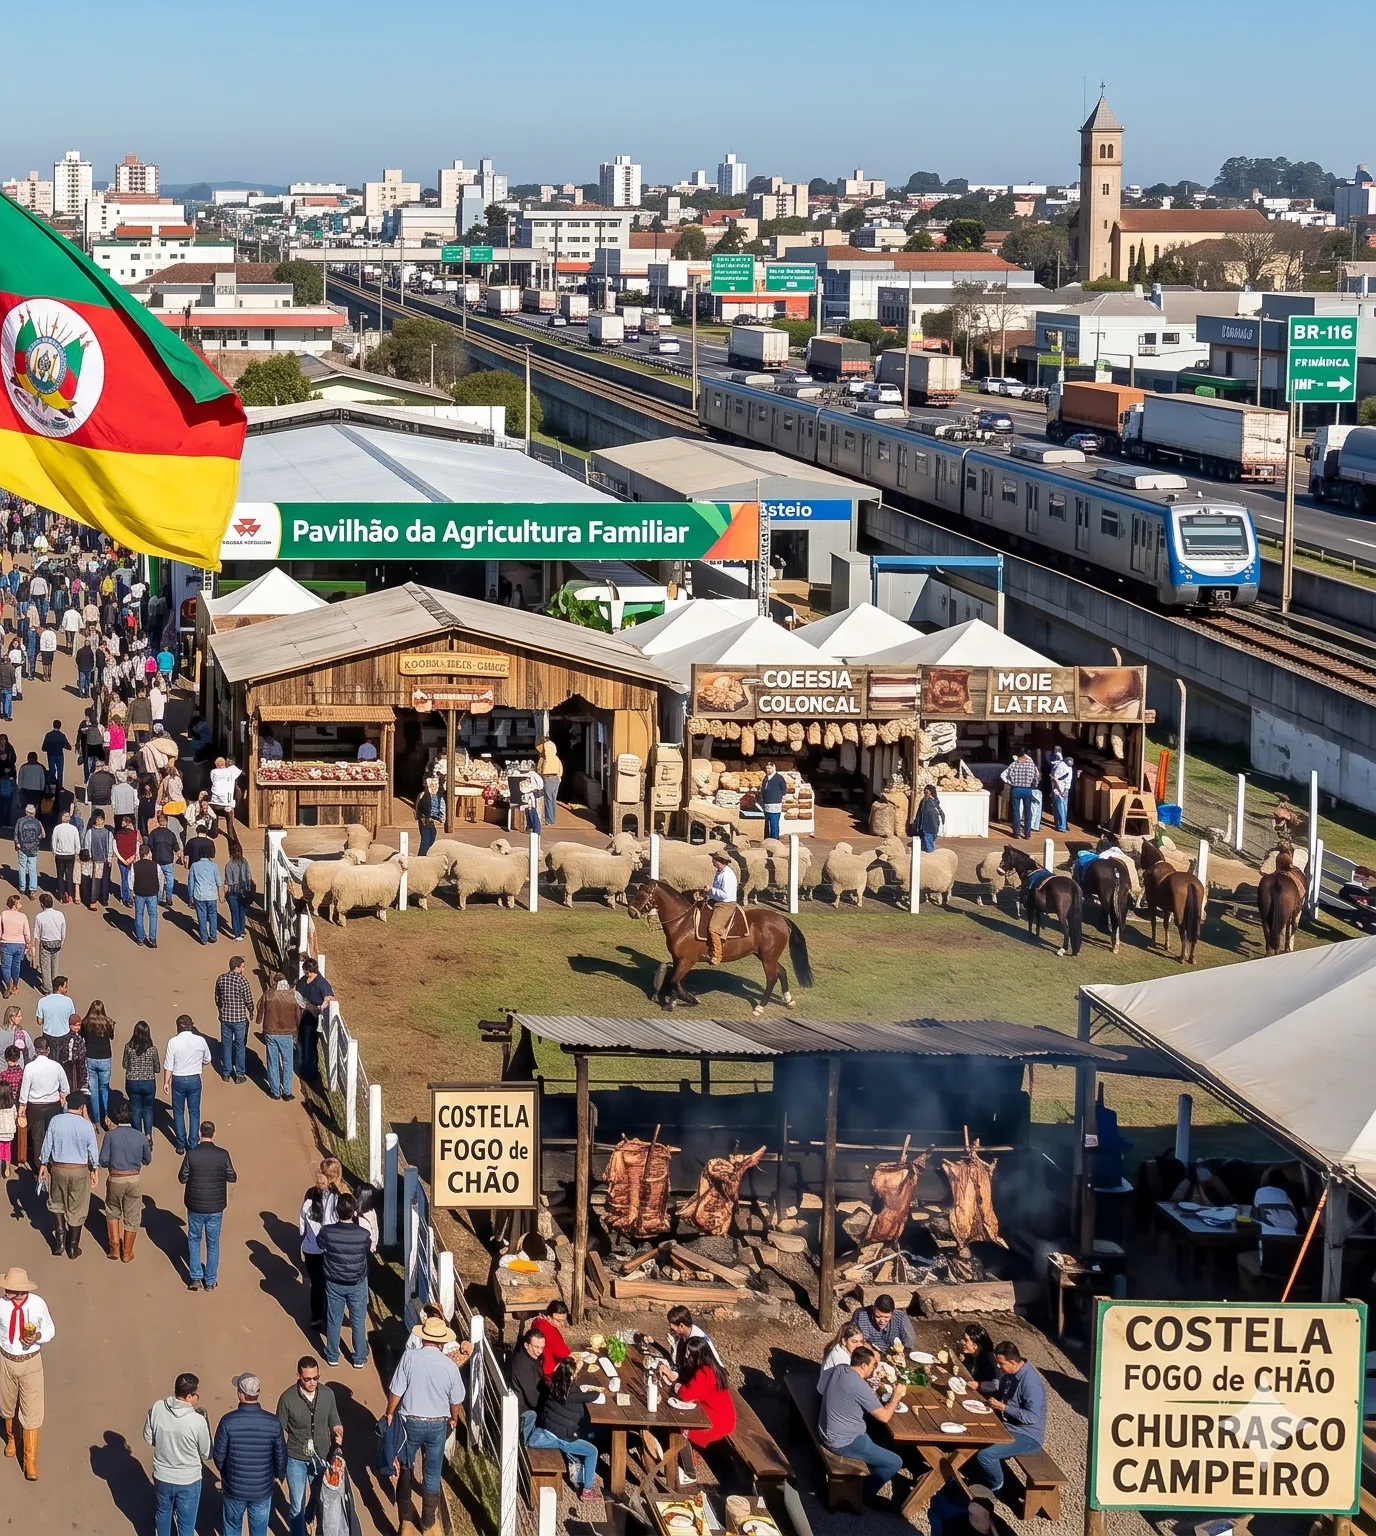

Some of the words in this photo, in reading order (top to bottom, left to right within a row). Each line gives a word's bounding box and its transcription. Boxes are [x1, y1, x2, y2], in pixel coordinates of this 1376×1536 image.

[1294, 324, 1352, 340] BR-116
[293, 518, 399, 543] Pavilhão
[405, 518, 436, 543] da
[442, 520, 582, 549] Agricultura
[588, 520, 690, 543] Familiar
[764, 670, 852, 688] COEESIA
[998, 672, 1052, 690] MOIE
[758, 696, 860, 713] COLONCAL
[994, 696, 1068, 714] LATRA
[438, 1104, 530, 1129] COSTELA
[440, 1139, 504, 1161] FOGO
[509, 1140, 528, 1160] de
[447, 1166, 520, 1194] CHÃO
[1125, 1315, 1333, 1354] COSTELA
[1124, 1364, 1202, 1391] FOGO
[1212, 1366, 1244, 1392] de
[1254, 1359, 1334, 1394] CHÃO
[1110, 1413, 1346, 1452] CHURRASCO
[1112, 1458, 1330, 1497] CAMPEIRO
